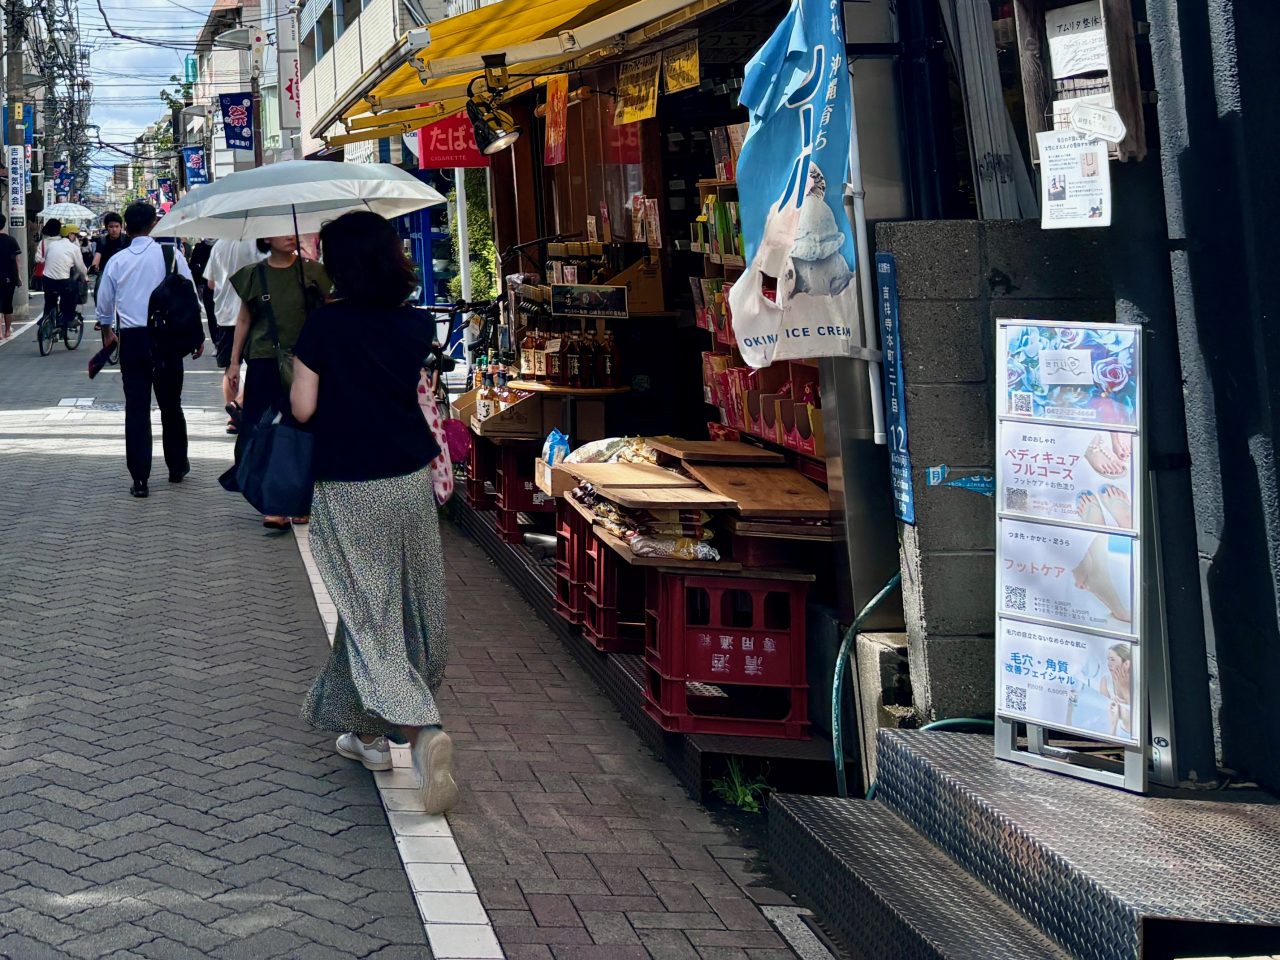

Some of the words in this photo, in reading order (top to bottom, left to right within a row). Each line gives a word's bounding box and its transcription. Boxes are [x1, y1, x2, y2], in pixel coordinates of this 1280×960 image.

[228, 105, 248, 127] 祭
[785, 327, 811, 338] ICE
[817, 326, 852, 338] CREAM
[890, 425, 907, 452] 12
[1005, 448, 1080, 467] ペディキュア
[1012, 463, 1073, 481] フルコース
[1004, 558, 1065, 578] フットケア
[1010, 652, 1069, 675] 毛穴・角質
[1005, 663, 1075, 686] 改善フェイシャル
